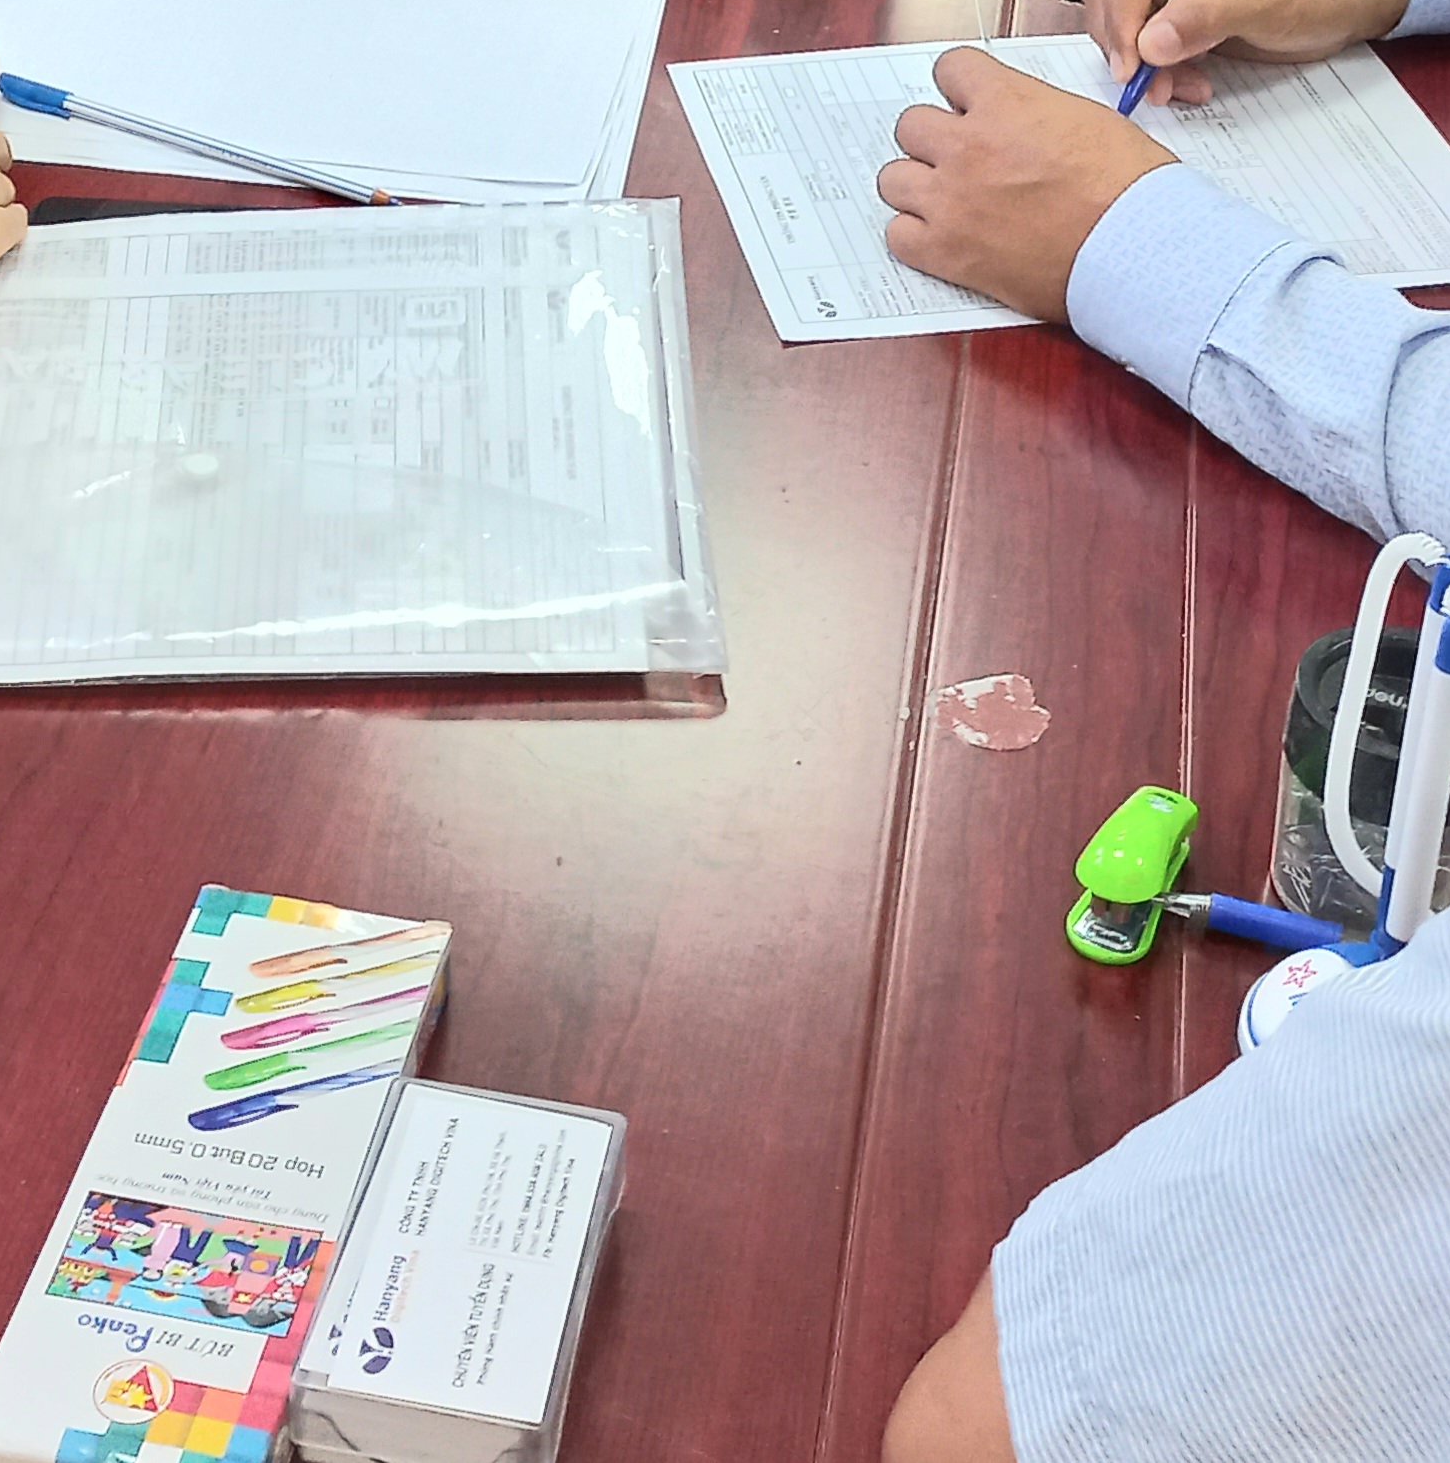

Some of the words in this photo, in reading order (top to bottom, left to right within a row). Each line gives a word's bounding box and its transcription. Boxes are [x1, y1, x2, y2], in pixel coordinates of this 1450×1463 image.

[247, 1152, 279, 1172] 20
[415, 1186, 438, 1239] HANYANG
[429, 1139, 452, 1187] DIGITECH
[444, 1115, 460, 1140] VINA
[396, 1203, 416, 1235] CÔNG
[407, 1189, 419, 1203] TY
[371, 1253, 408, 1323] Hanyang
[76, 1312, 154, 1354] Penko
[154, 1328, 183, 1346] BI
[185, 1335, 236, 1358] BÚT
